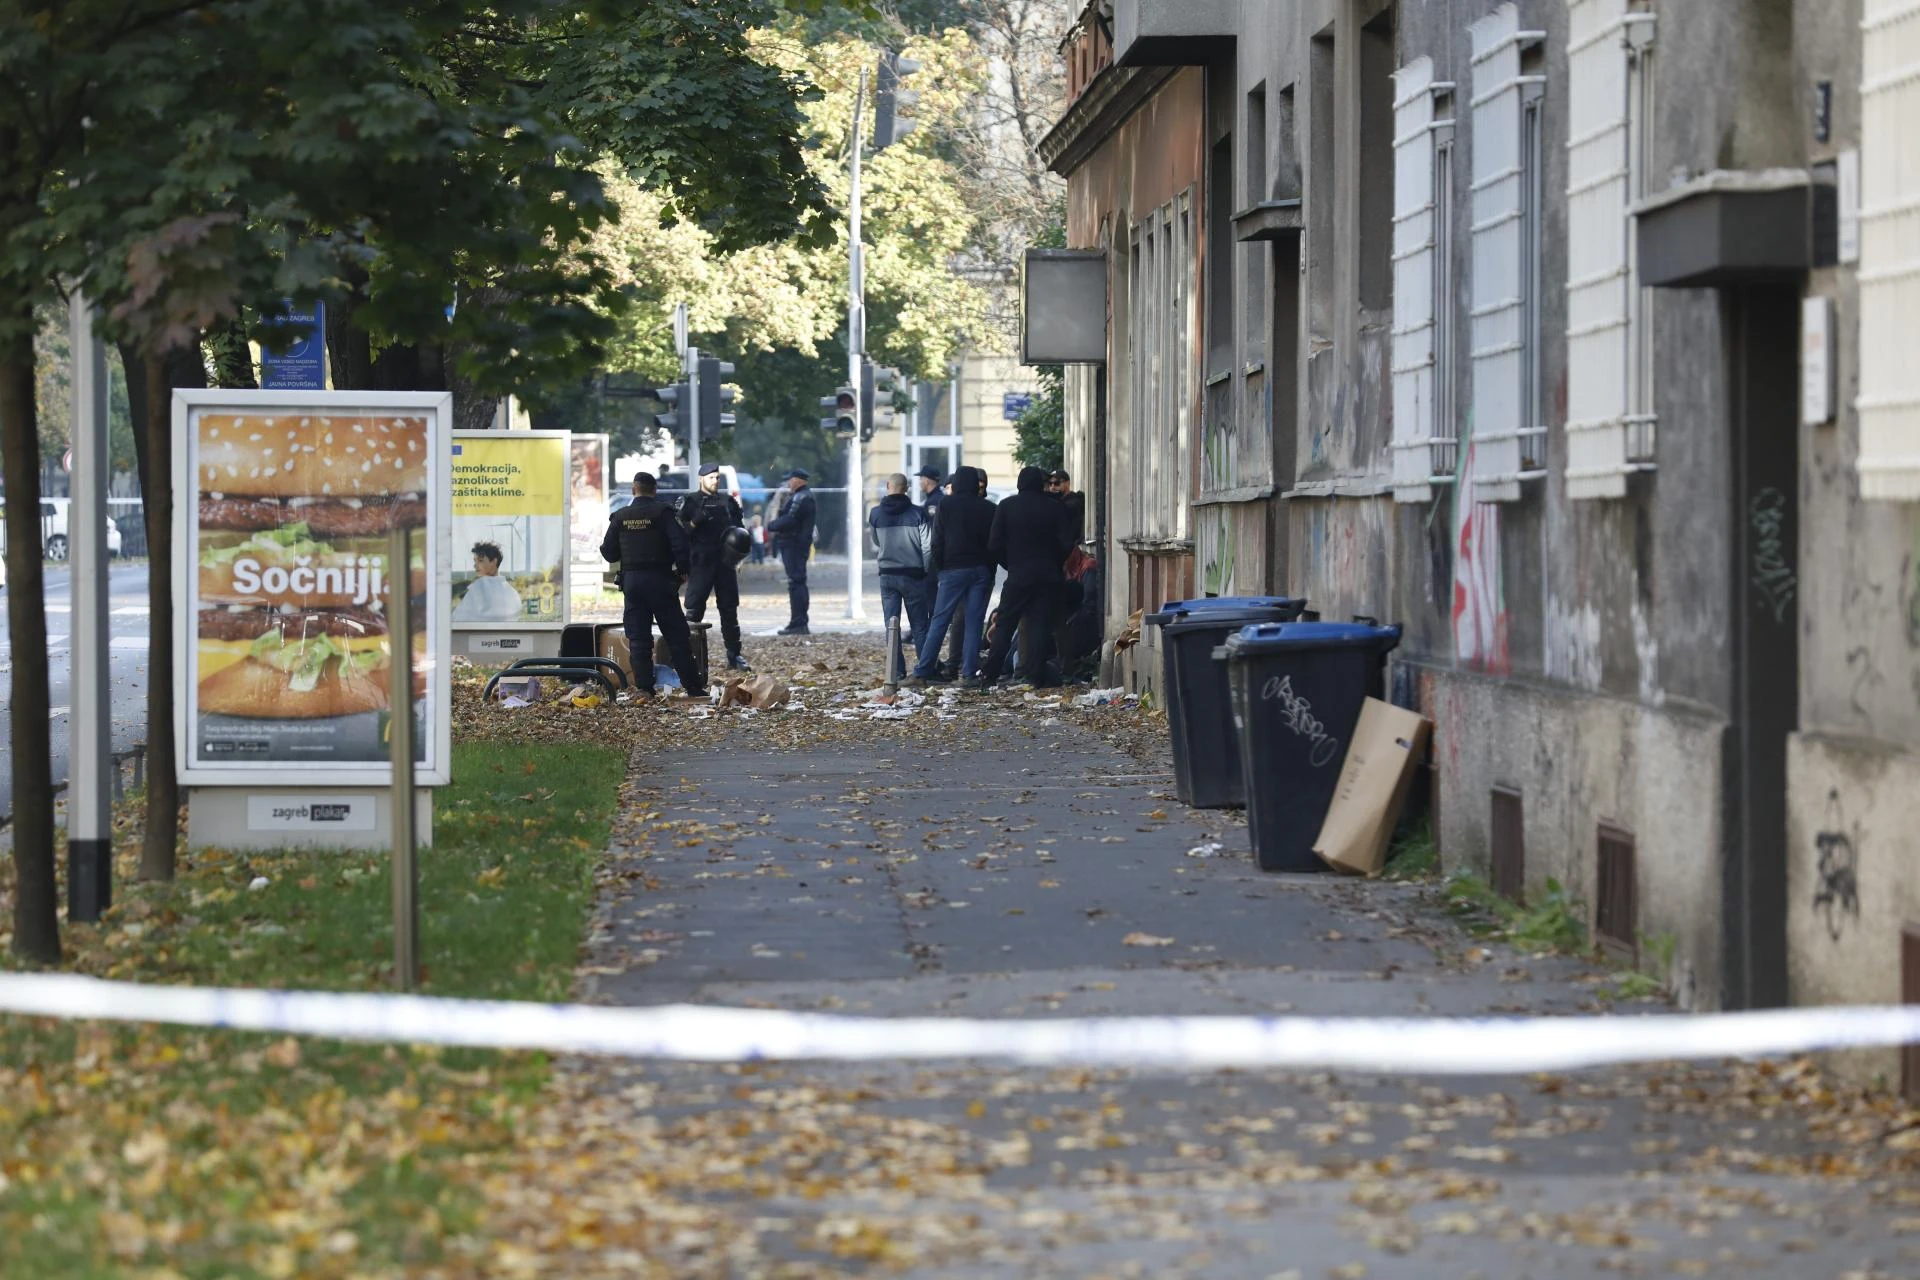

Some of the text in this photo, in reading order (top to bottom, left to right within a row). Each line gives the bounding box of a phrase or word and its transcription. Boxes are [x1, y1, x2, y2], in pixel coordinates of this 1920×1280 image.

[452, 487, 525, 497] zaštita klime.
[232, 556, 390, 605] Sočniji.
[272, 804, 309, 821] zagreb
